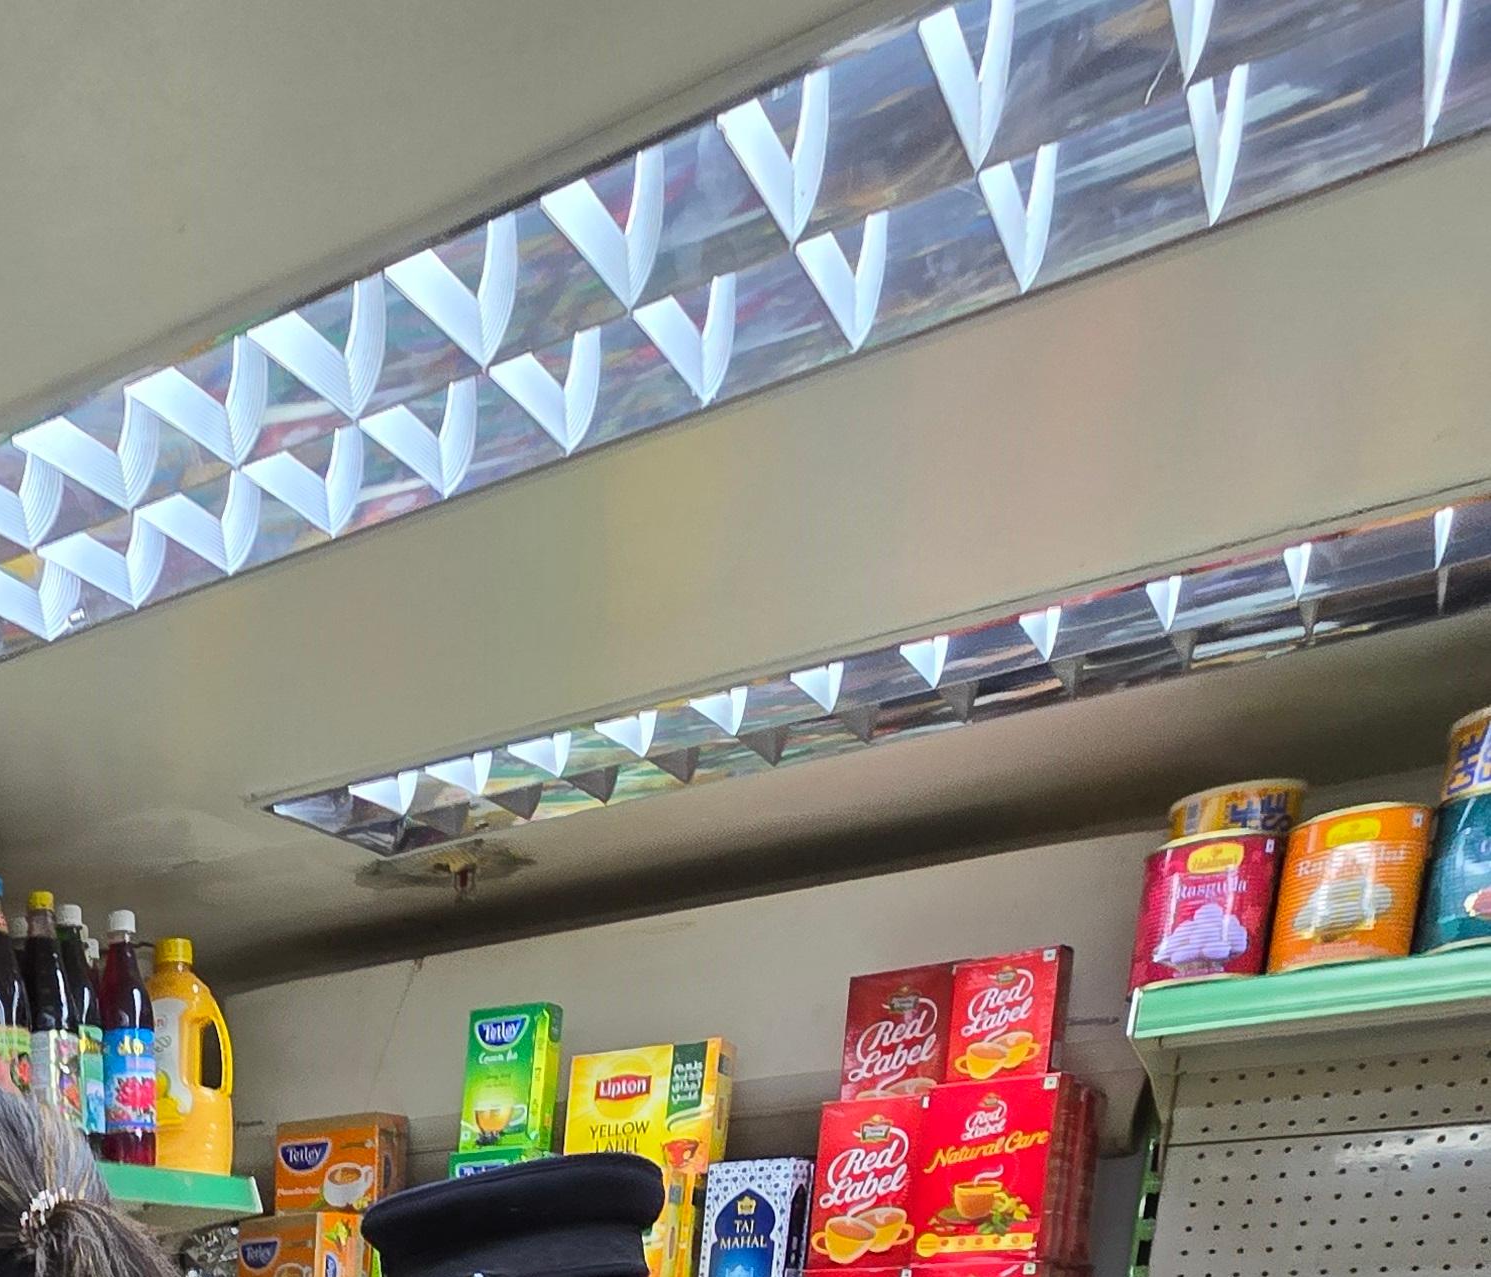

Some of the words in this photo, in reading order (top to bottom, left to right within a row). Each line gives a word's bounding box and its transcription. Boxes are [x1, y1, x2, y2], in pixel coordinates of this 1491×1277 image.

[968, 968, 1034, 1024] Red
[857, 998, 938, 1057] Red
[960, 1003, 1034, 1038] Label
[848, 1042, 936, 1084] Label
[597, 1075, 650, 1100] Lipton
[589, 1121, 651, 1138] YELLOW
[961, 1121, 1007, 1141] Label
[965, 1099, 1007, 1130] Red
[828, 1128, 909, 1181] Red
[923, 1138, 1004, 1174] Natural
[1004, 1130, 1050, 1156] Care
[819, 1167, 908, 1209] Label
[719, 1234, 768, 1250] MAHAL
[734, 1219, 756, 1235] TAJ
